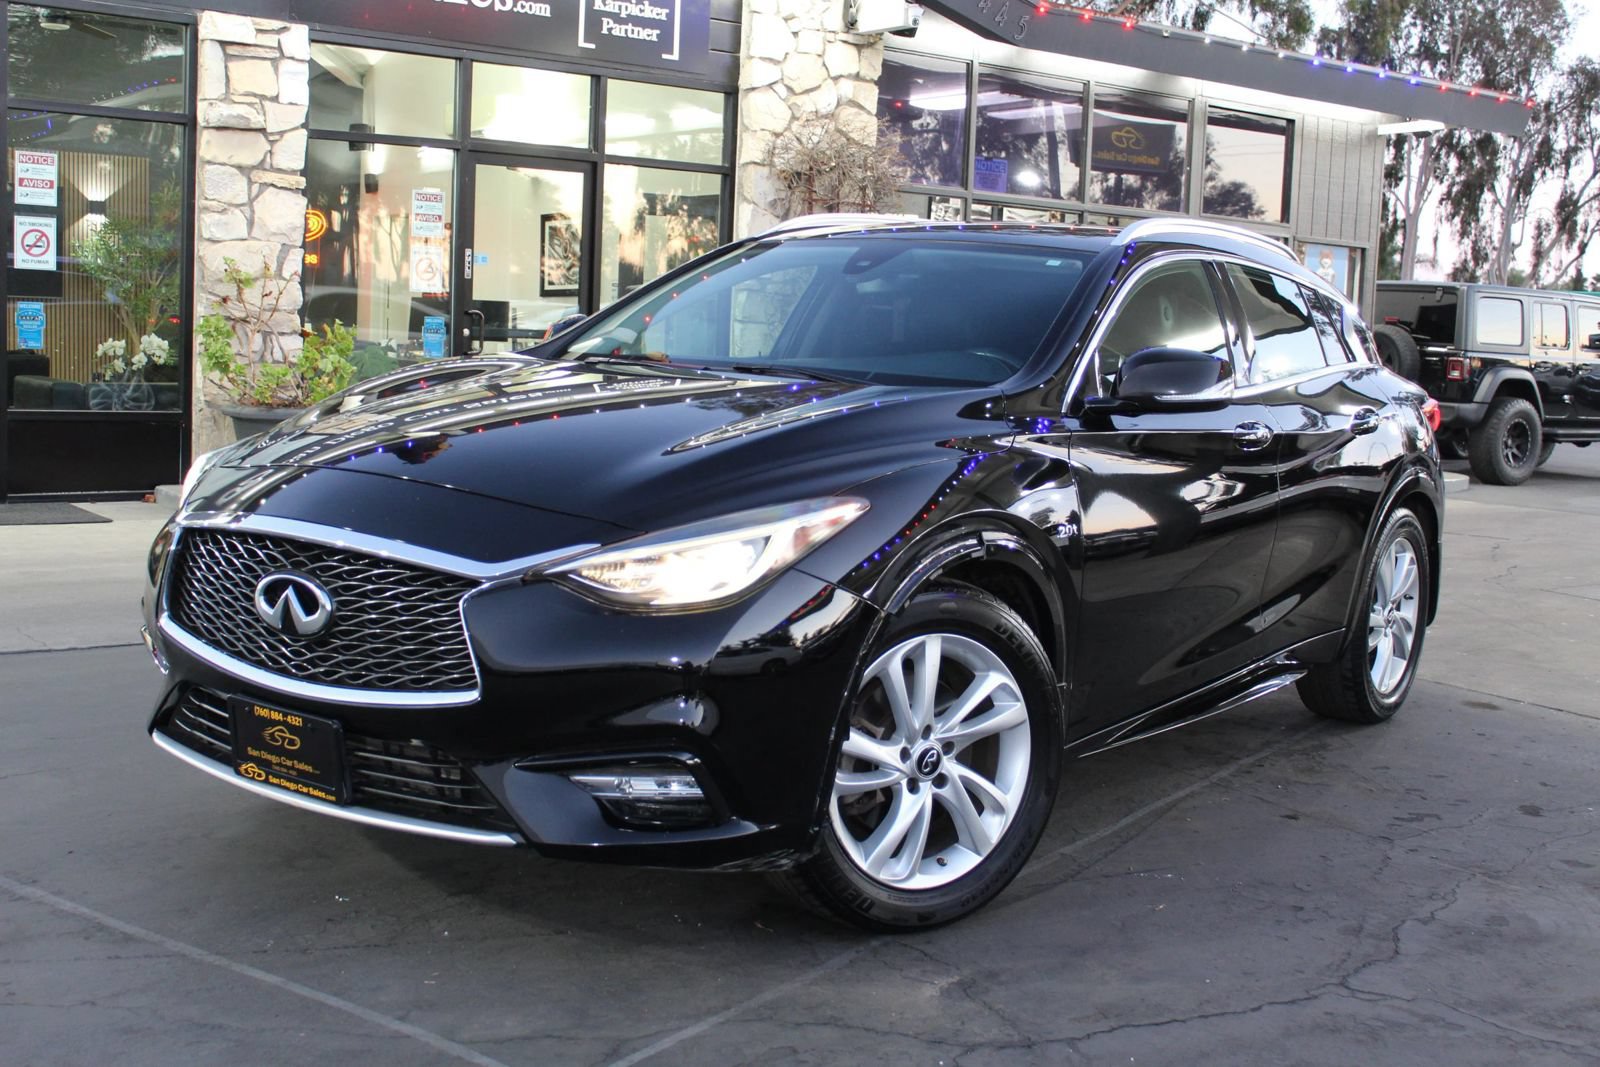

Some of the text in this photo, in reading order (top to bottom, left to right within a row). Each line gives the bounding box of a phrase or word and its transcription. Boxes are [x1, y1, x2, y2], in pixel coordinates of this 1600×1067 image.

[593, 0, 669, 20] Karpicker
[601, 17, 660, 42] Partner
[19, 154, 55, 166] NOTICE
[22, 179, 50, 188] AVISO
[415, 193, 442, 203] NOTICE
[254, 705, 270, 720] (760)
[247, 746, 260, 757] San
[260, 750, 280, 763] Diego
[280, 757, 294, 766] Car
[268, 775, 280, 785] San
[280, 779, 298, 790] Diego
[297, 784, 310, 793] Car
